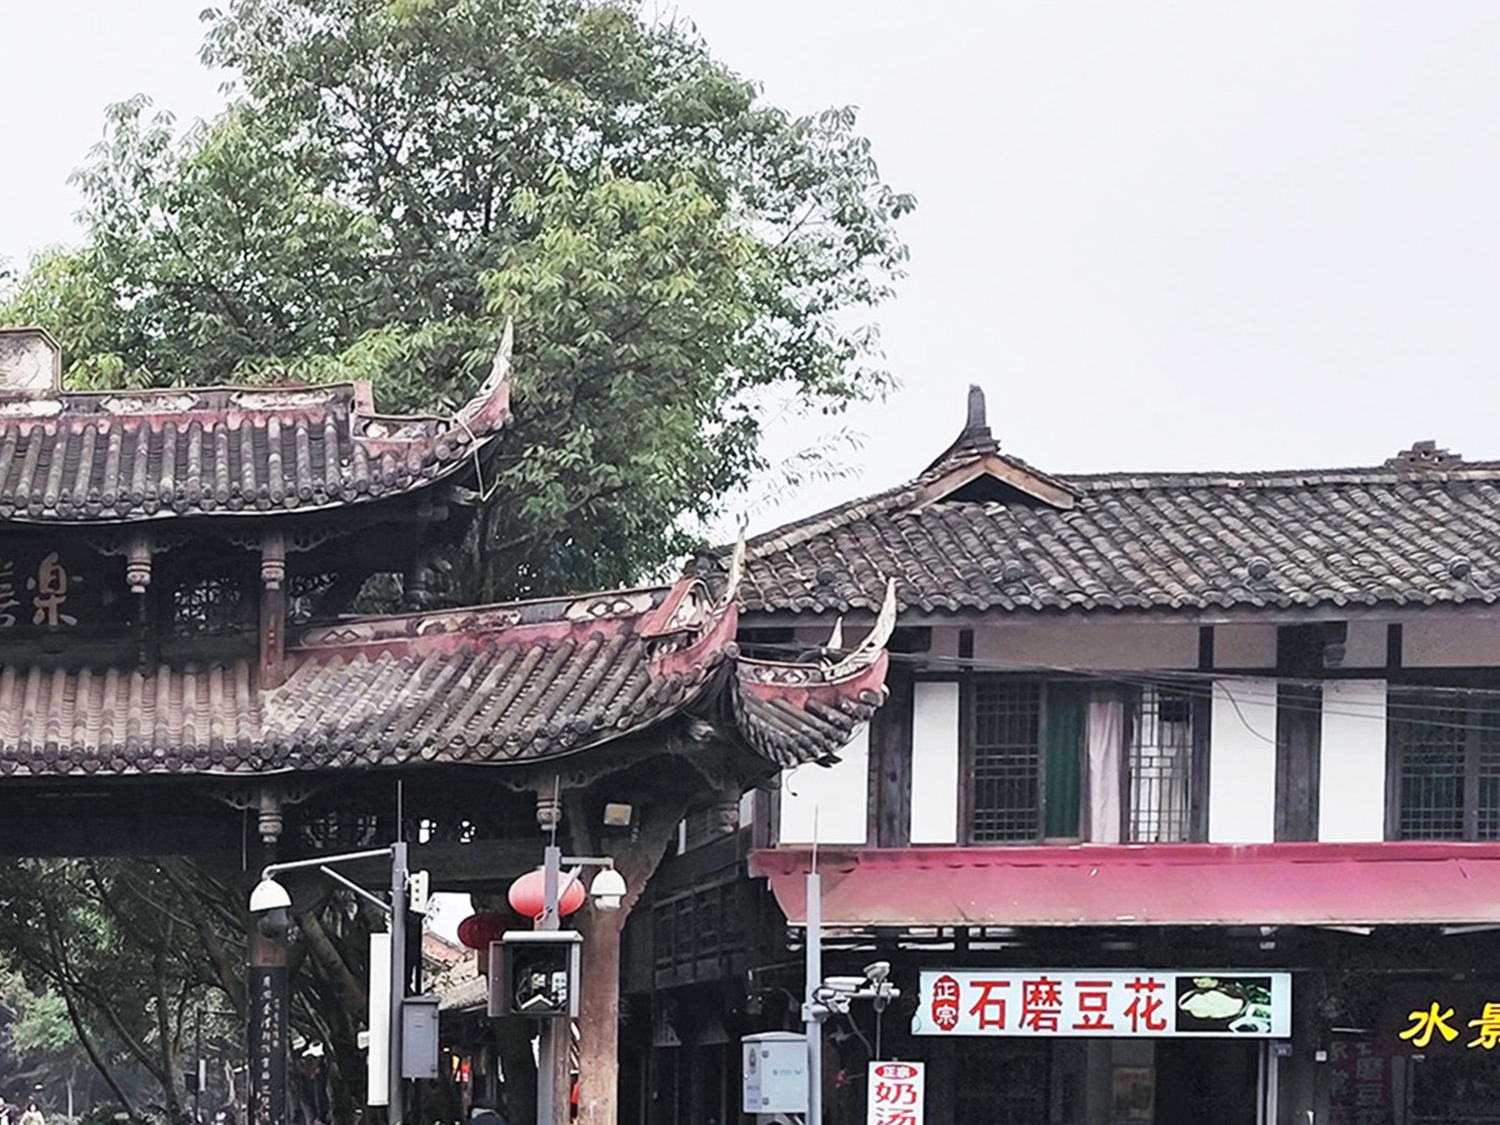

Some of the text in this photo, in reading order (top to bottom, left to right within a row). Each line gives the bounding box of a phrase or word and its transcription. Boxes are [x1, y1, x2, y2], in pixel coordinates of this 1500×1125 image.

[935, 981, 958, 1026] 正宗
[969, 976, 1167, 1032] 石磨豆花
[1399, 1002, 1500, 1049] 水景
